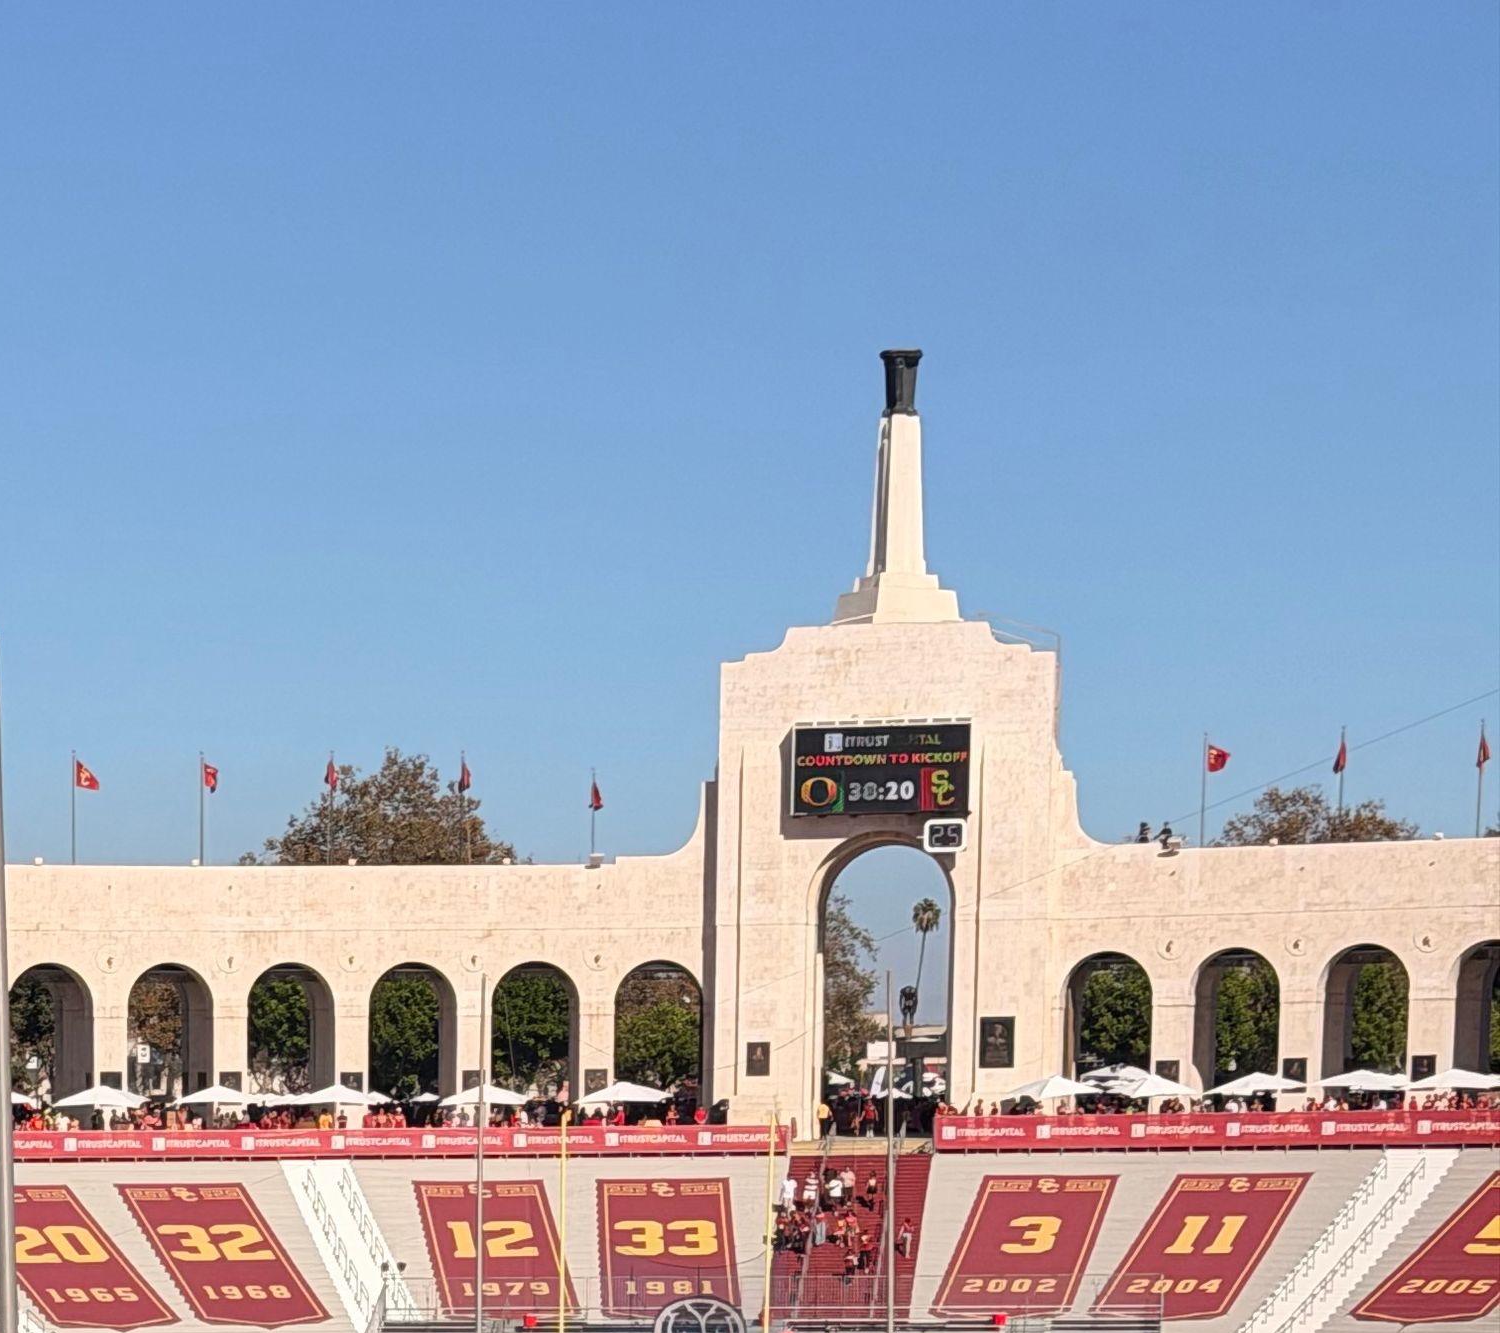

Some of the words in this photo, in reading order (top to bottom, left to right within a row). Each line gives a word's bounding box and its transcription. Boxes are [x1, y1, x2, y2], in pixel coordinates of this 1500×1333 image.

[797, 753, 887, 767] COUNTDOWN
[889, 753, 908, 765] TO
[911, 751, 967, 765] KICKOFF
[848, 780, 914, 802] 38:20
[156, 1224, 277, 1261] 32
[446, 1220, 540, 1258] 12
[613, 1220, 719, 1256] 33
[1001, 1216, 1062, 1254] 3
[1164, 1215, 1248, 1254] 11
[15, 1225, 110, 1263] 20
[202, 1284, 292, 1300] 1968
[462, 1281, 551, 1297] 1979
[626, 1280, 715, 1295] 1981
[962, 1279, 1057, 1293] 2002
[1126, 1279, 1223, 1294] 2004
[1396, 1279, 1497, 1294] 2005
[45, 1287, 140, 1303] 1965
